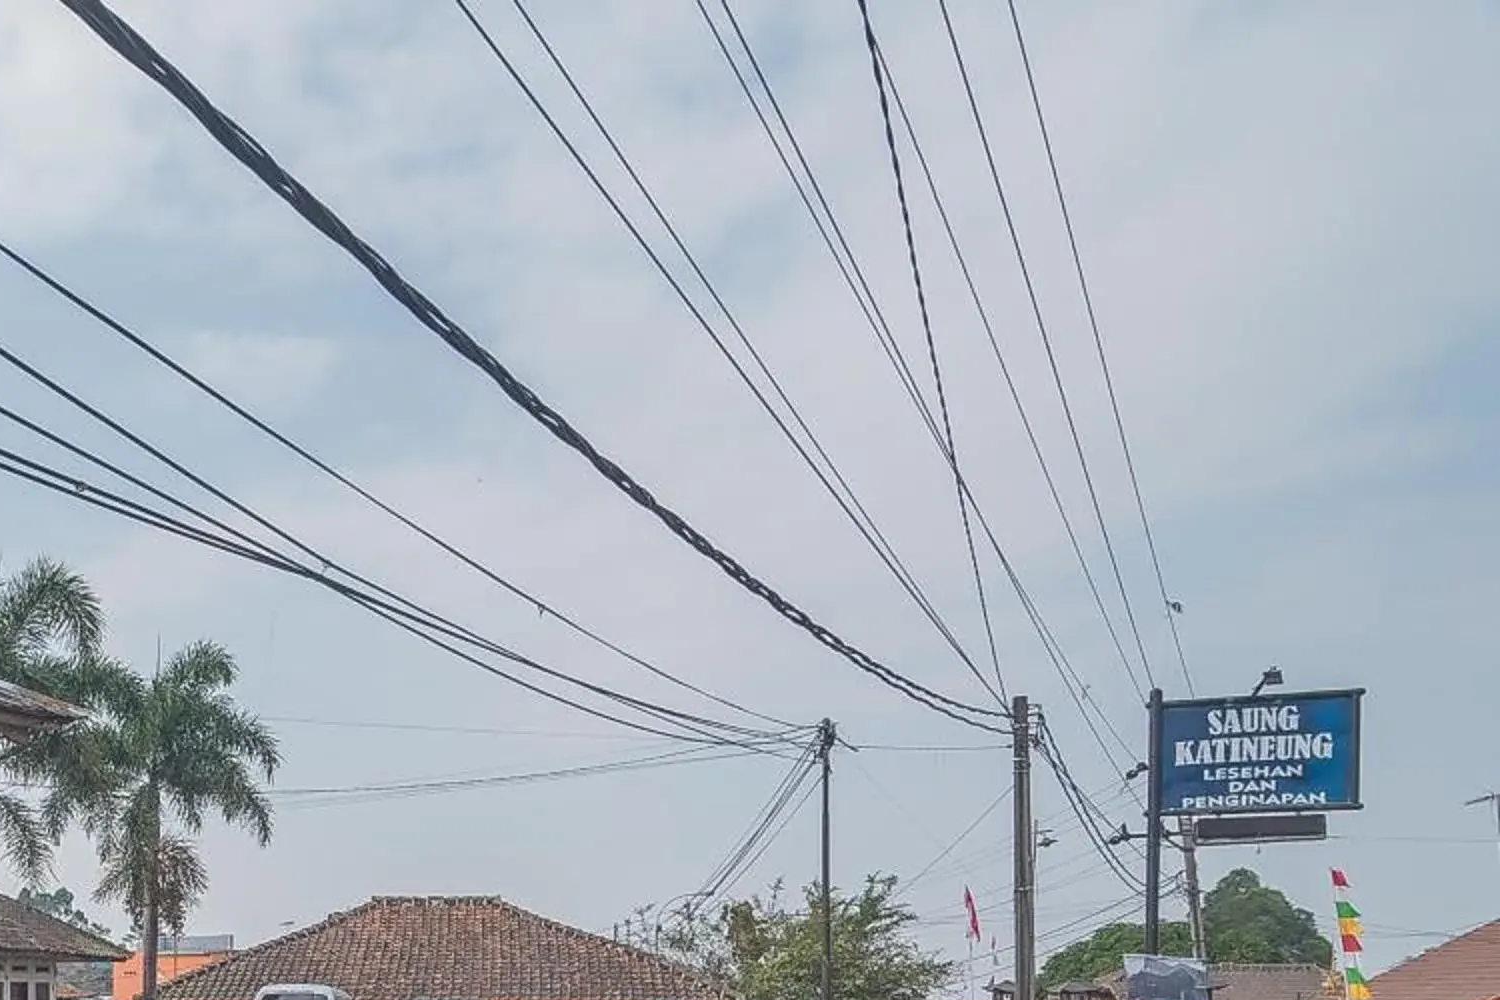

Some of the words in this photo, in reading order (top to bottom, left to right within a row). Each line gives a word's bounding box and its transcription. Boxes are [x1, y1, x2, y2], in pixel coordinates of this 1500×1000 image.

[1207, 705, 1300, 735] SAUNG
[1174, 733, 1333, 767] KATINEUNG
[1203, 765, 1303, 781] LESEHAN
[1229, 780, 1276, 793] DAN
[1182, 793, 1327, 809] PENGINAPAN
